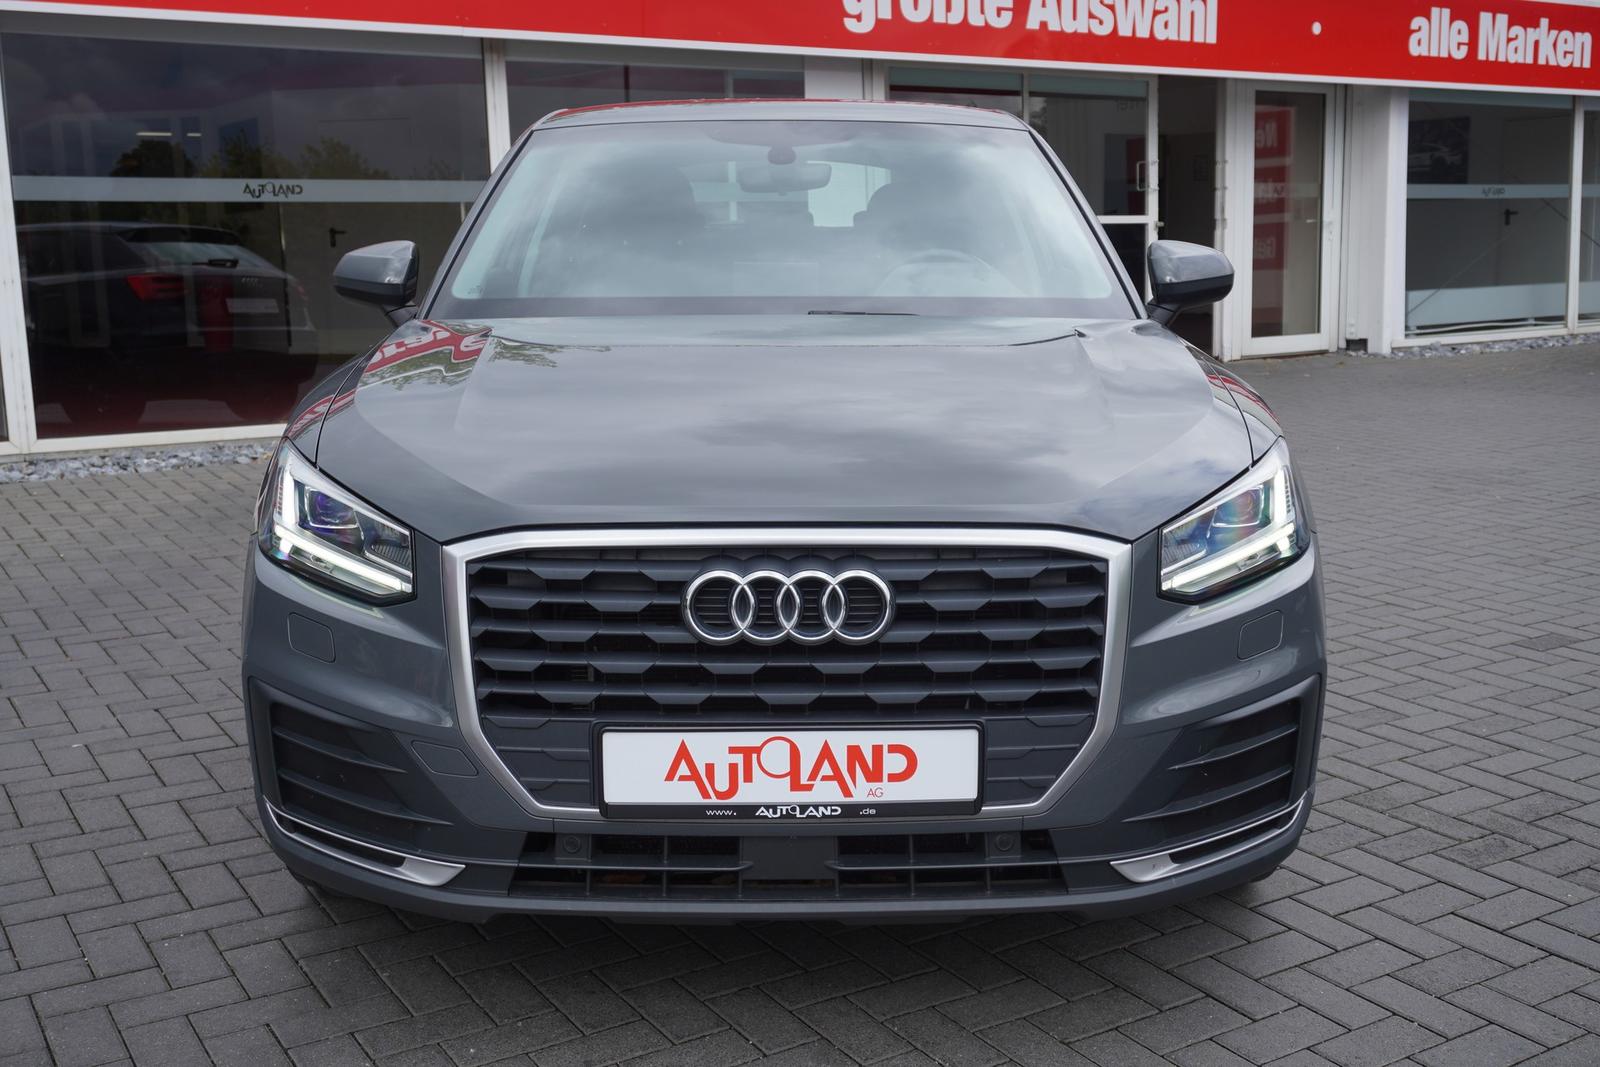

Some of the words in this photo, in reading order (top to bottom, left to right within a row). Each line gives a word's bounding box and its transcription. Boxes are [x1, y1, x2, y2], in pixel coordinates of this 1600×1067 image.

[1408, 6, 1469, 60] alle
[1477, 11, 1592, 69] Marken
[243, 180, 303, 199] AUTOLAND
[664, 736, 918, 801] AUTOLAND
[866, 787, 884, 798] AG
[755, 804, 842, 818] AUTOLAND
